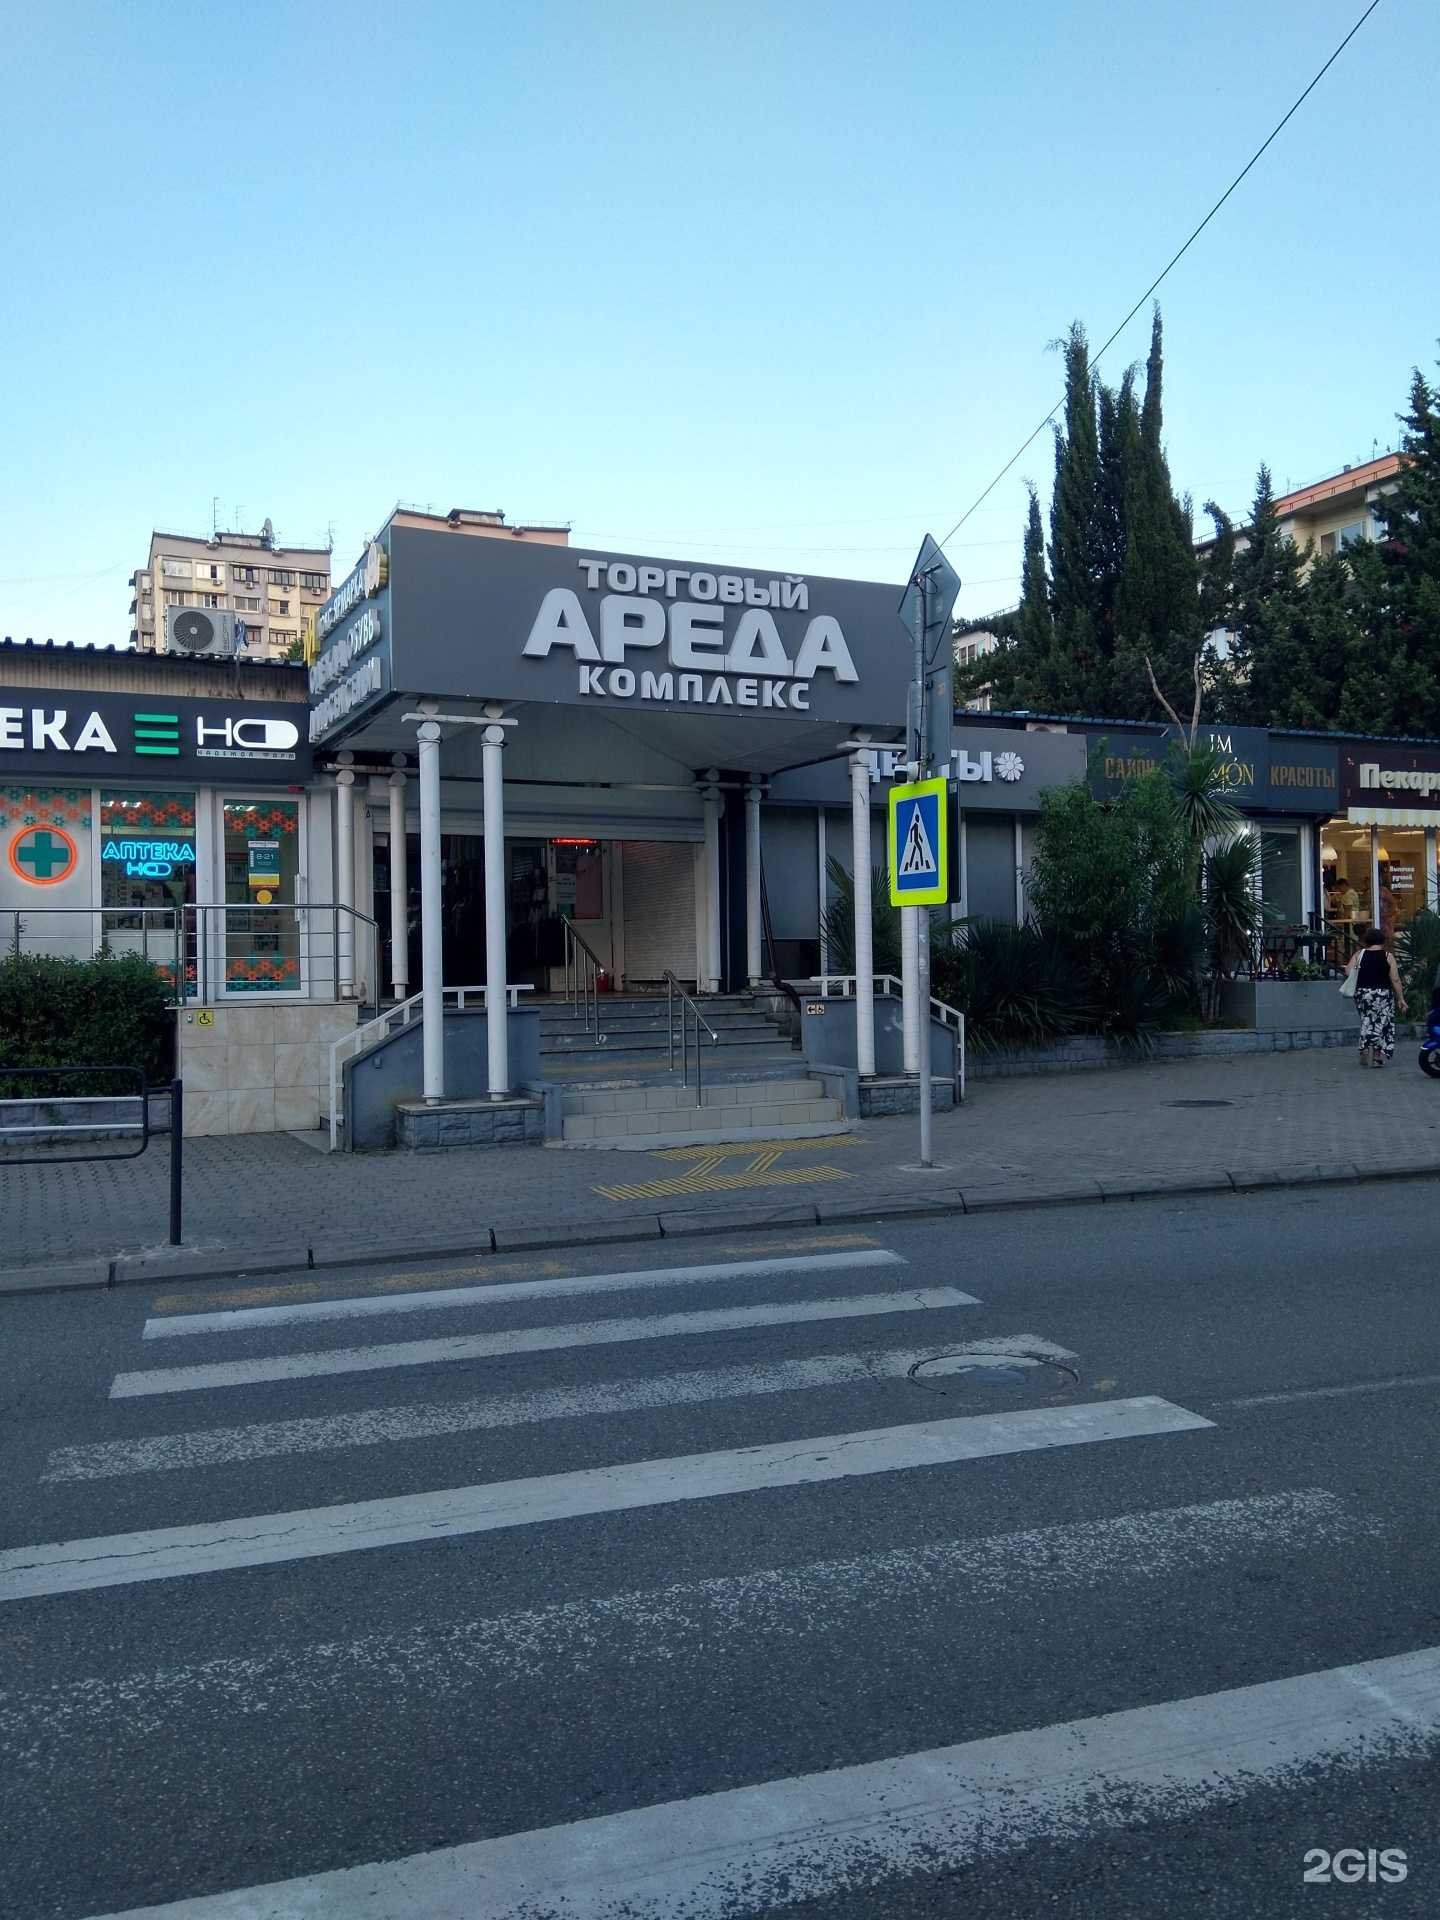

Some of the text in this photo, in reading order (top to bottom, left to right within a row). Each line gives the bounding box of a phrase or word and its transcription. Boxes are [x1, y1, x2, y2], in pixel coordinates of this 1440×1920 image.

[578, 558, 809, 611] ТОРГОВЫЙ
[521, 587, 860, 683] АРЕДА
[579, 665, 810, 710] КОМПЛЕКС
[1270, 765, 1336, 788] КРАСОТЫ
[1359, 763, 1440, 797] Пекар
[102, 841, 196, 861] АПТЕКА
